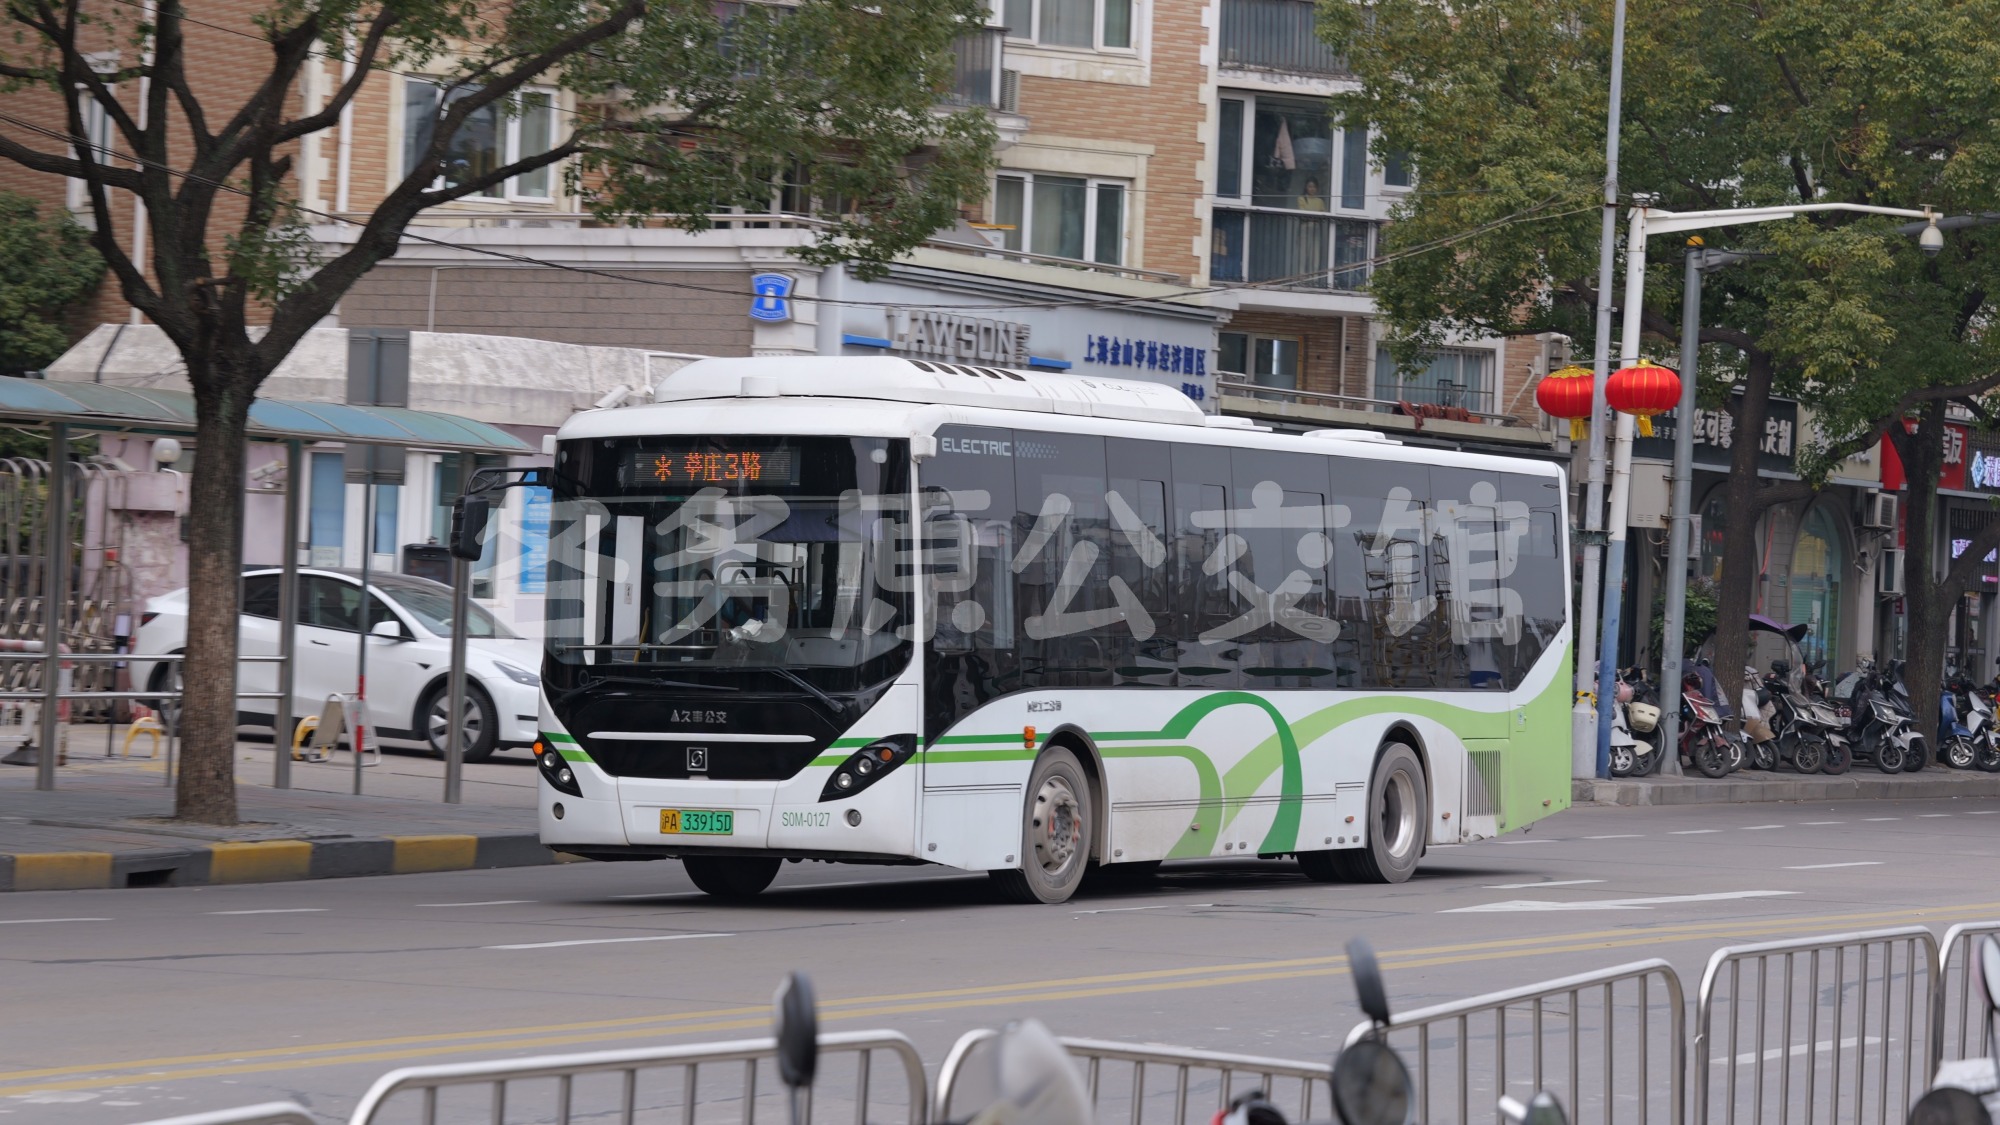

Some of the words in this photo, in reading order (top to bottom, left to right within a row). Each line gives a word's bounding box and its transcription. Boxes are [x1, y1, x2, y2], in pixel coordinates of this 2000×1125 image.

[885, 305, 1016, 362] LAWSON
[1084, 334, 1206, 376] 上海金山亭林经济园区
[941, 437, 1012, 457] ELECTRIC
[684, 451, 762, 481] 莘庄3路
